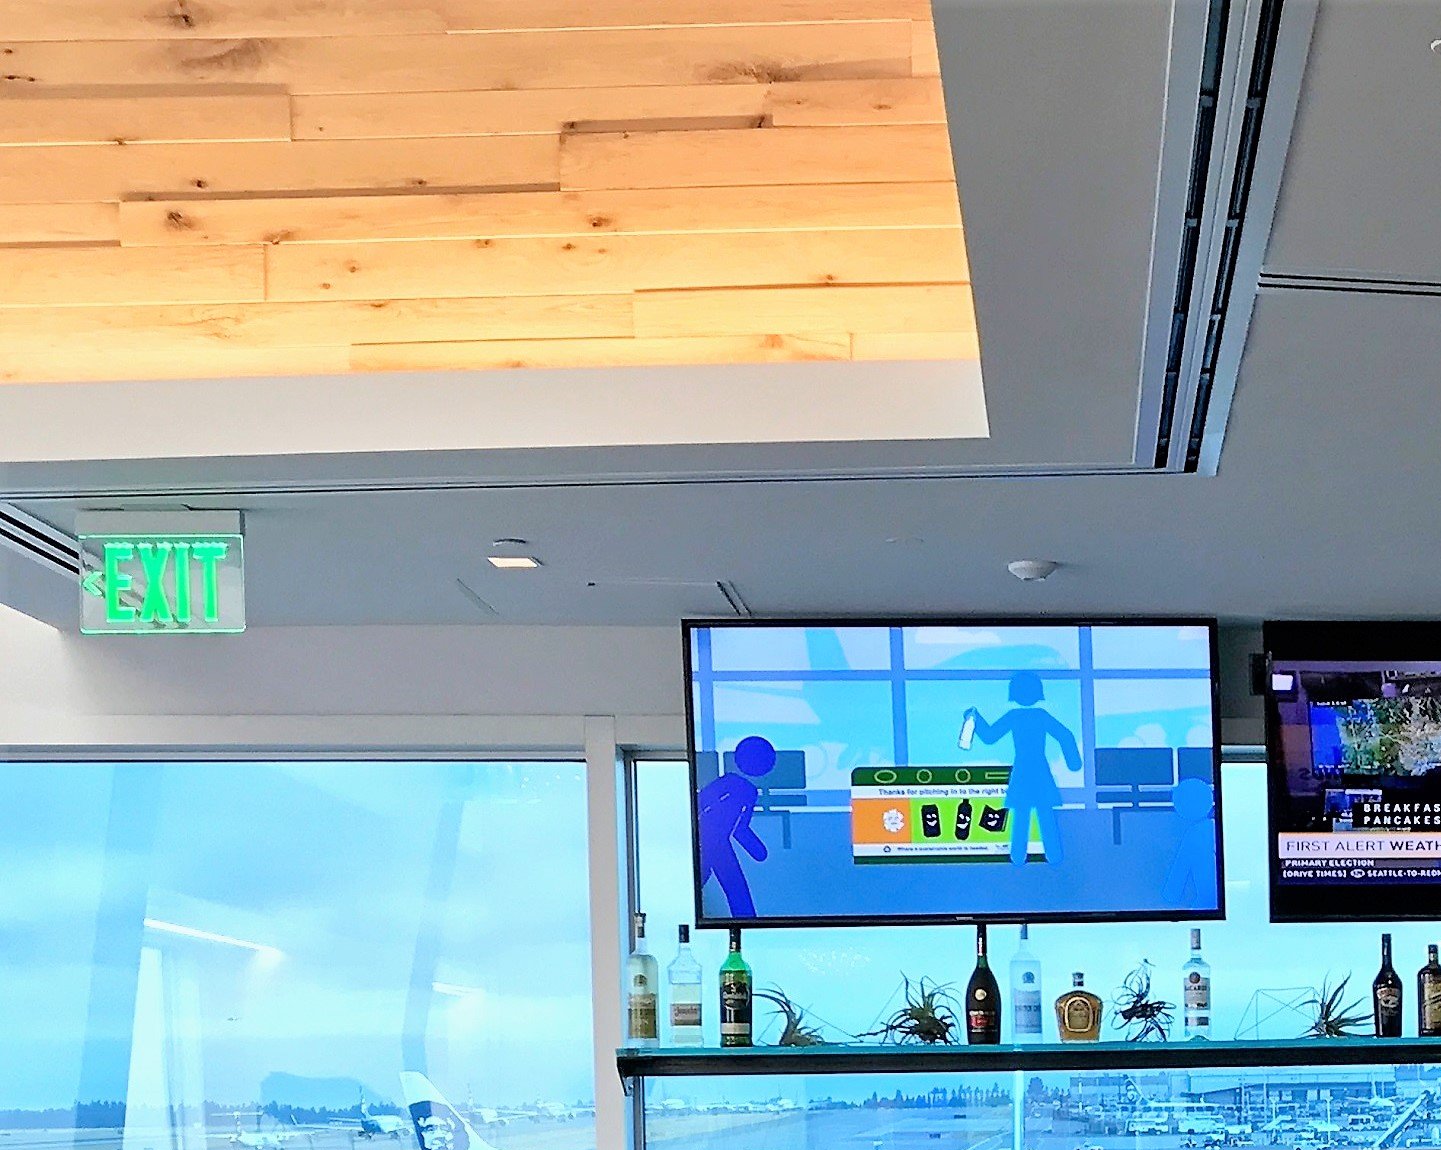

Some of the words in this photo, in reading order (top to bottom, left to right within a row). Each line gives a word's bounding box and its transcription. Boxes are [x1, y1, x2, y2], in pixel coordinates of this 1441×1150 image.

[104, 541, 228, 623] EXIT
[879, 788, 905, 796] Thanks
[907, 788, 918, 796] for
[981, 788, 999, 797] right
[1363, 815, 1441, 825] PANCAKES
[1286, 840, 1330, 852] FIRST
[1335, 840, 1386, 852] ALERT
[1285, 859, 1327, 867] PRIMARY
[1328, 859, 1375, 867] ELECTION
